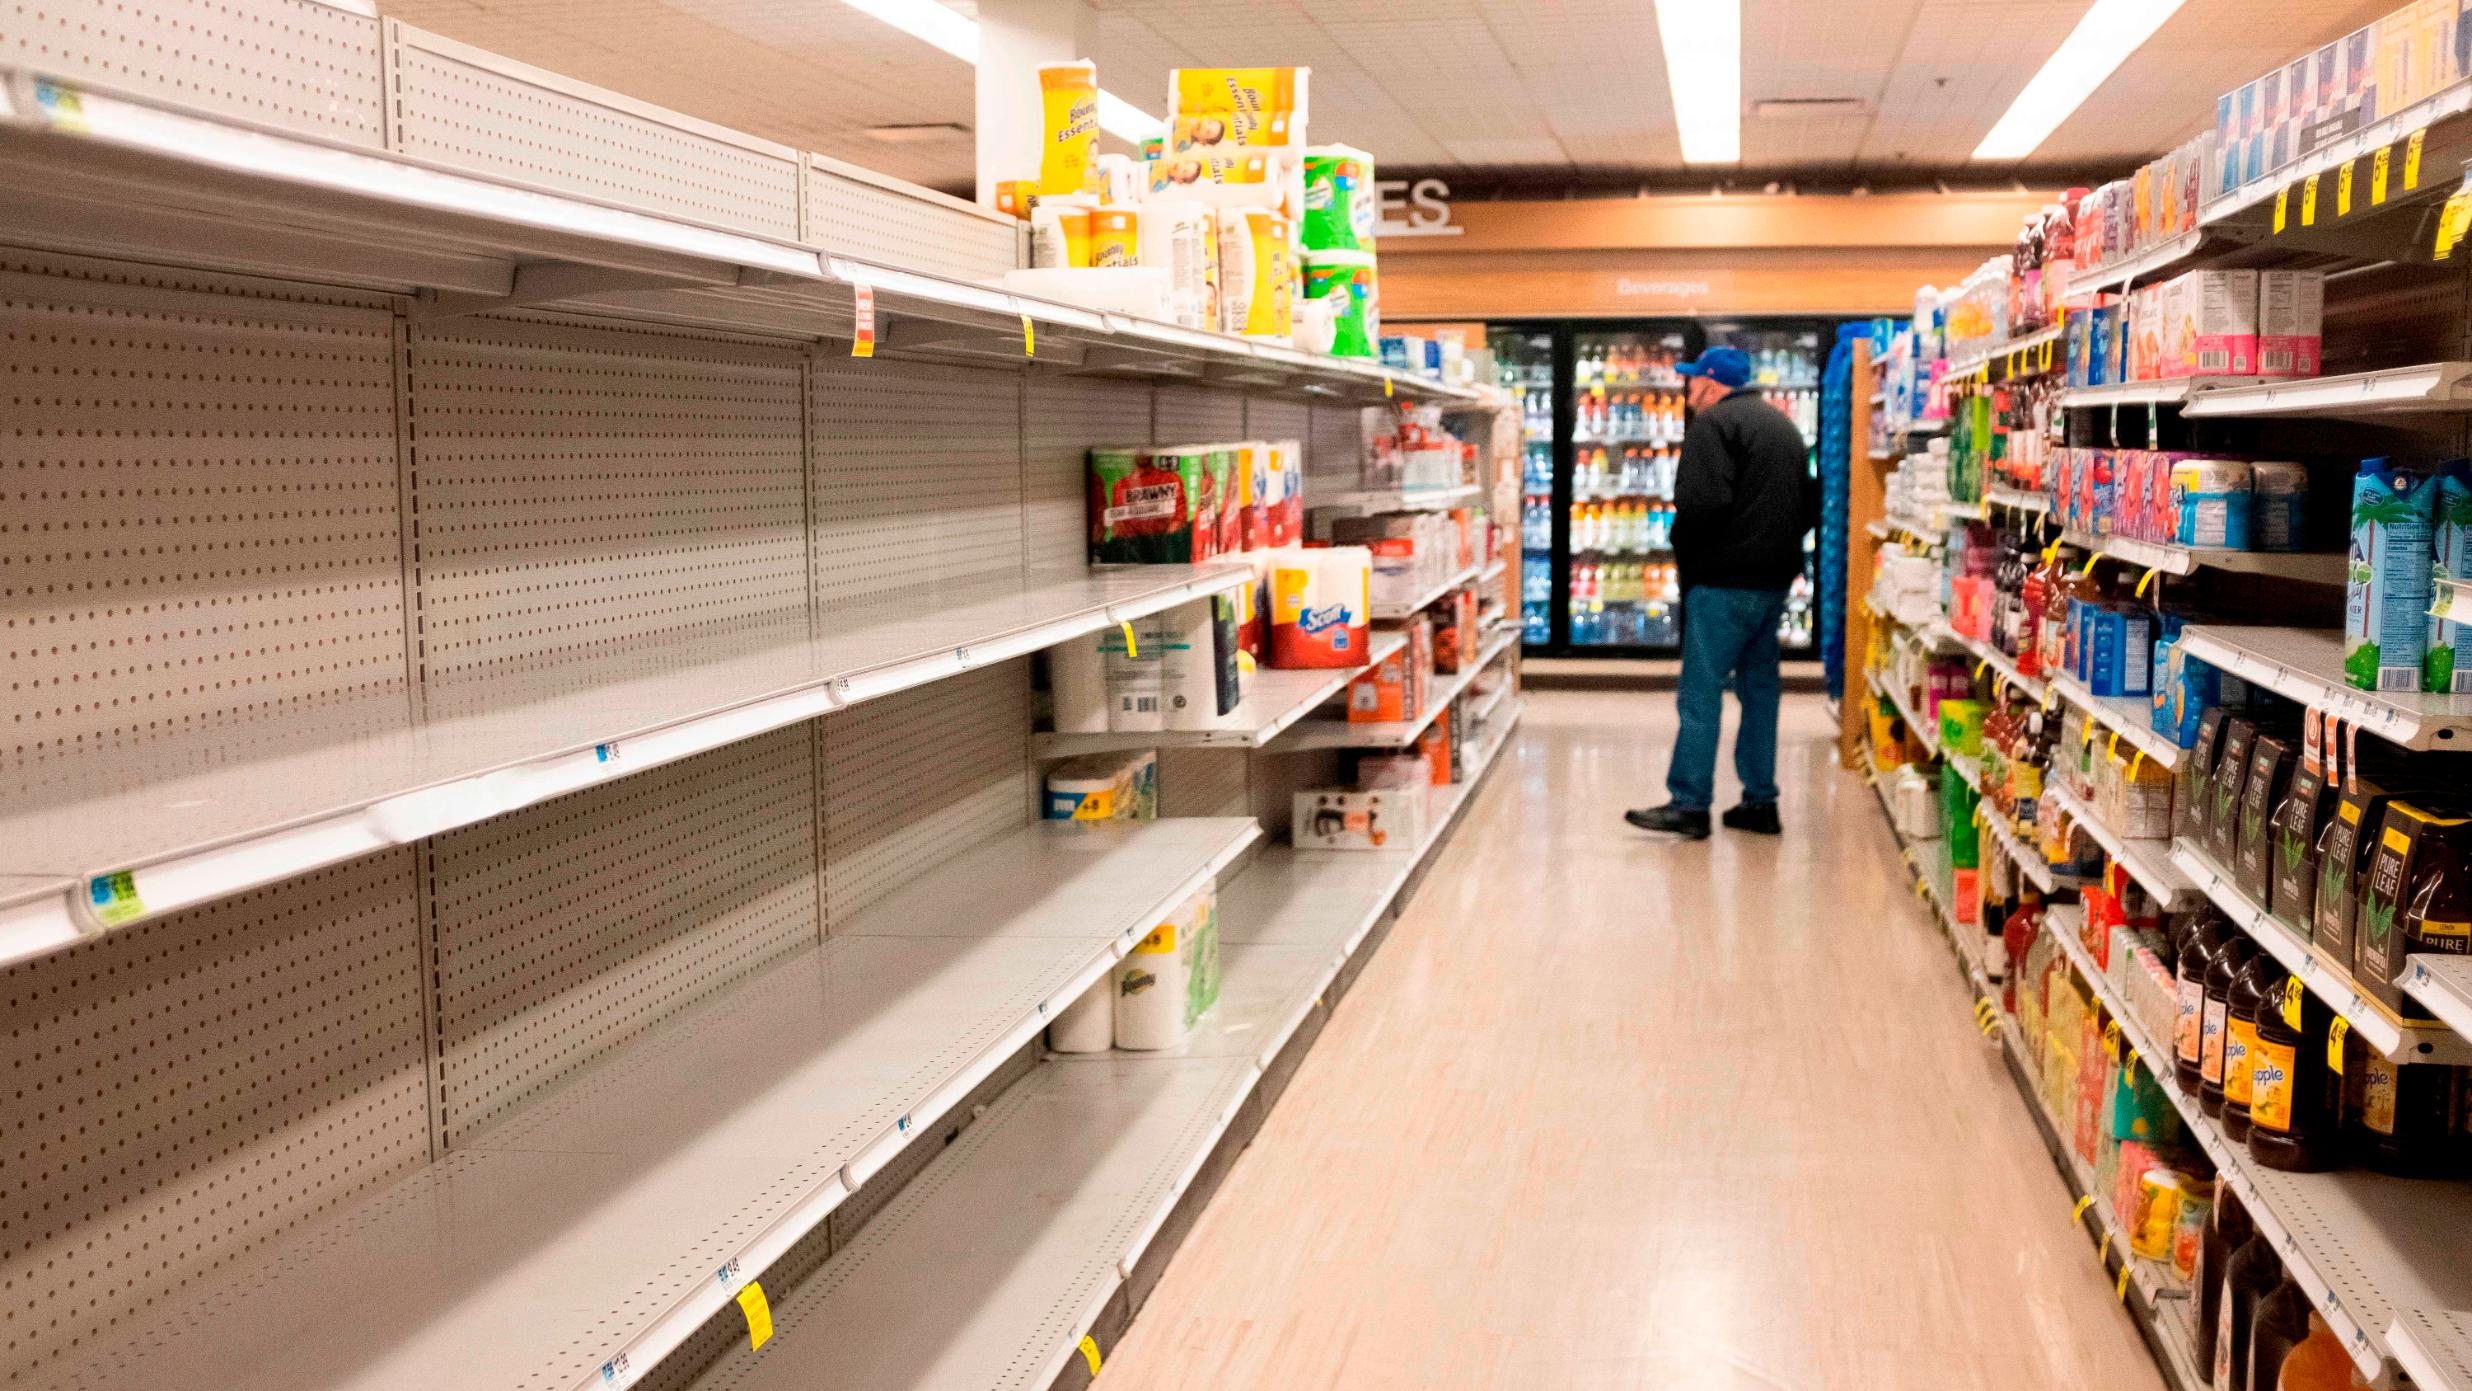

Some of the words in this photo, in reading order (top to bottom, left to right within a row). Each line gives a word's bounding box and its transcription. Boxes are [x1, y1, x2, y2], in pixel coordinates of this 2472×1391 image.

[1617, 279, 1708, 298] Beverages
[1126, 484, 1176, 504] BRAWNY
[2224, 757, 2240, 775] PURE
[2252, 775, 2265, 793] PURE
[2291, 798, 2309, 819] PURE
[2289, 813, 2306, 834] LEAF
[2336, 825, 2352, 848] PURE
[2332, 842, 2348, 865] LEAF
[2379, 853, 2401, 878] PURE
[2375, 872, 2397, 897] LEAF
